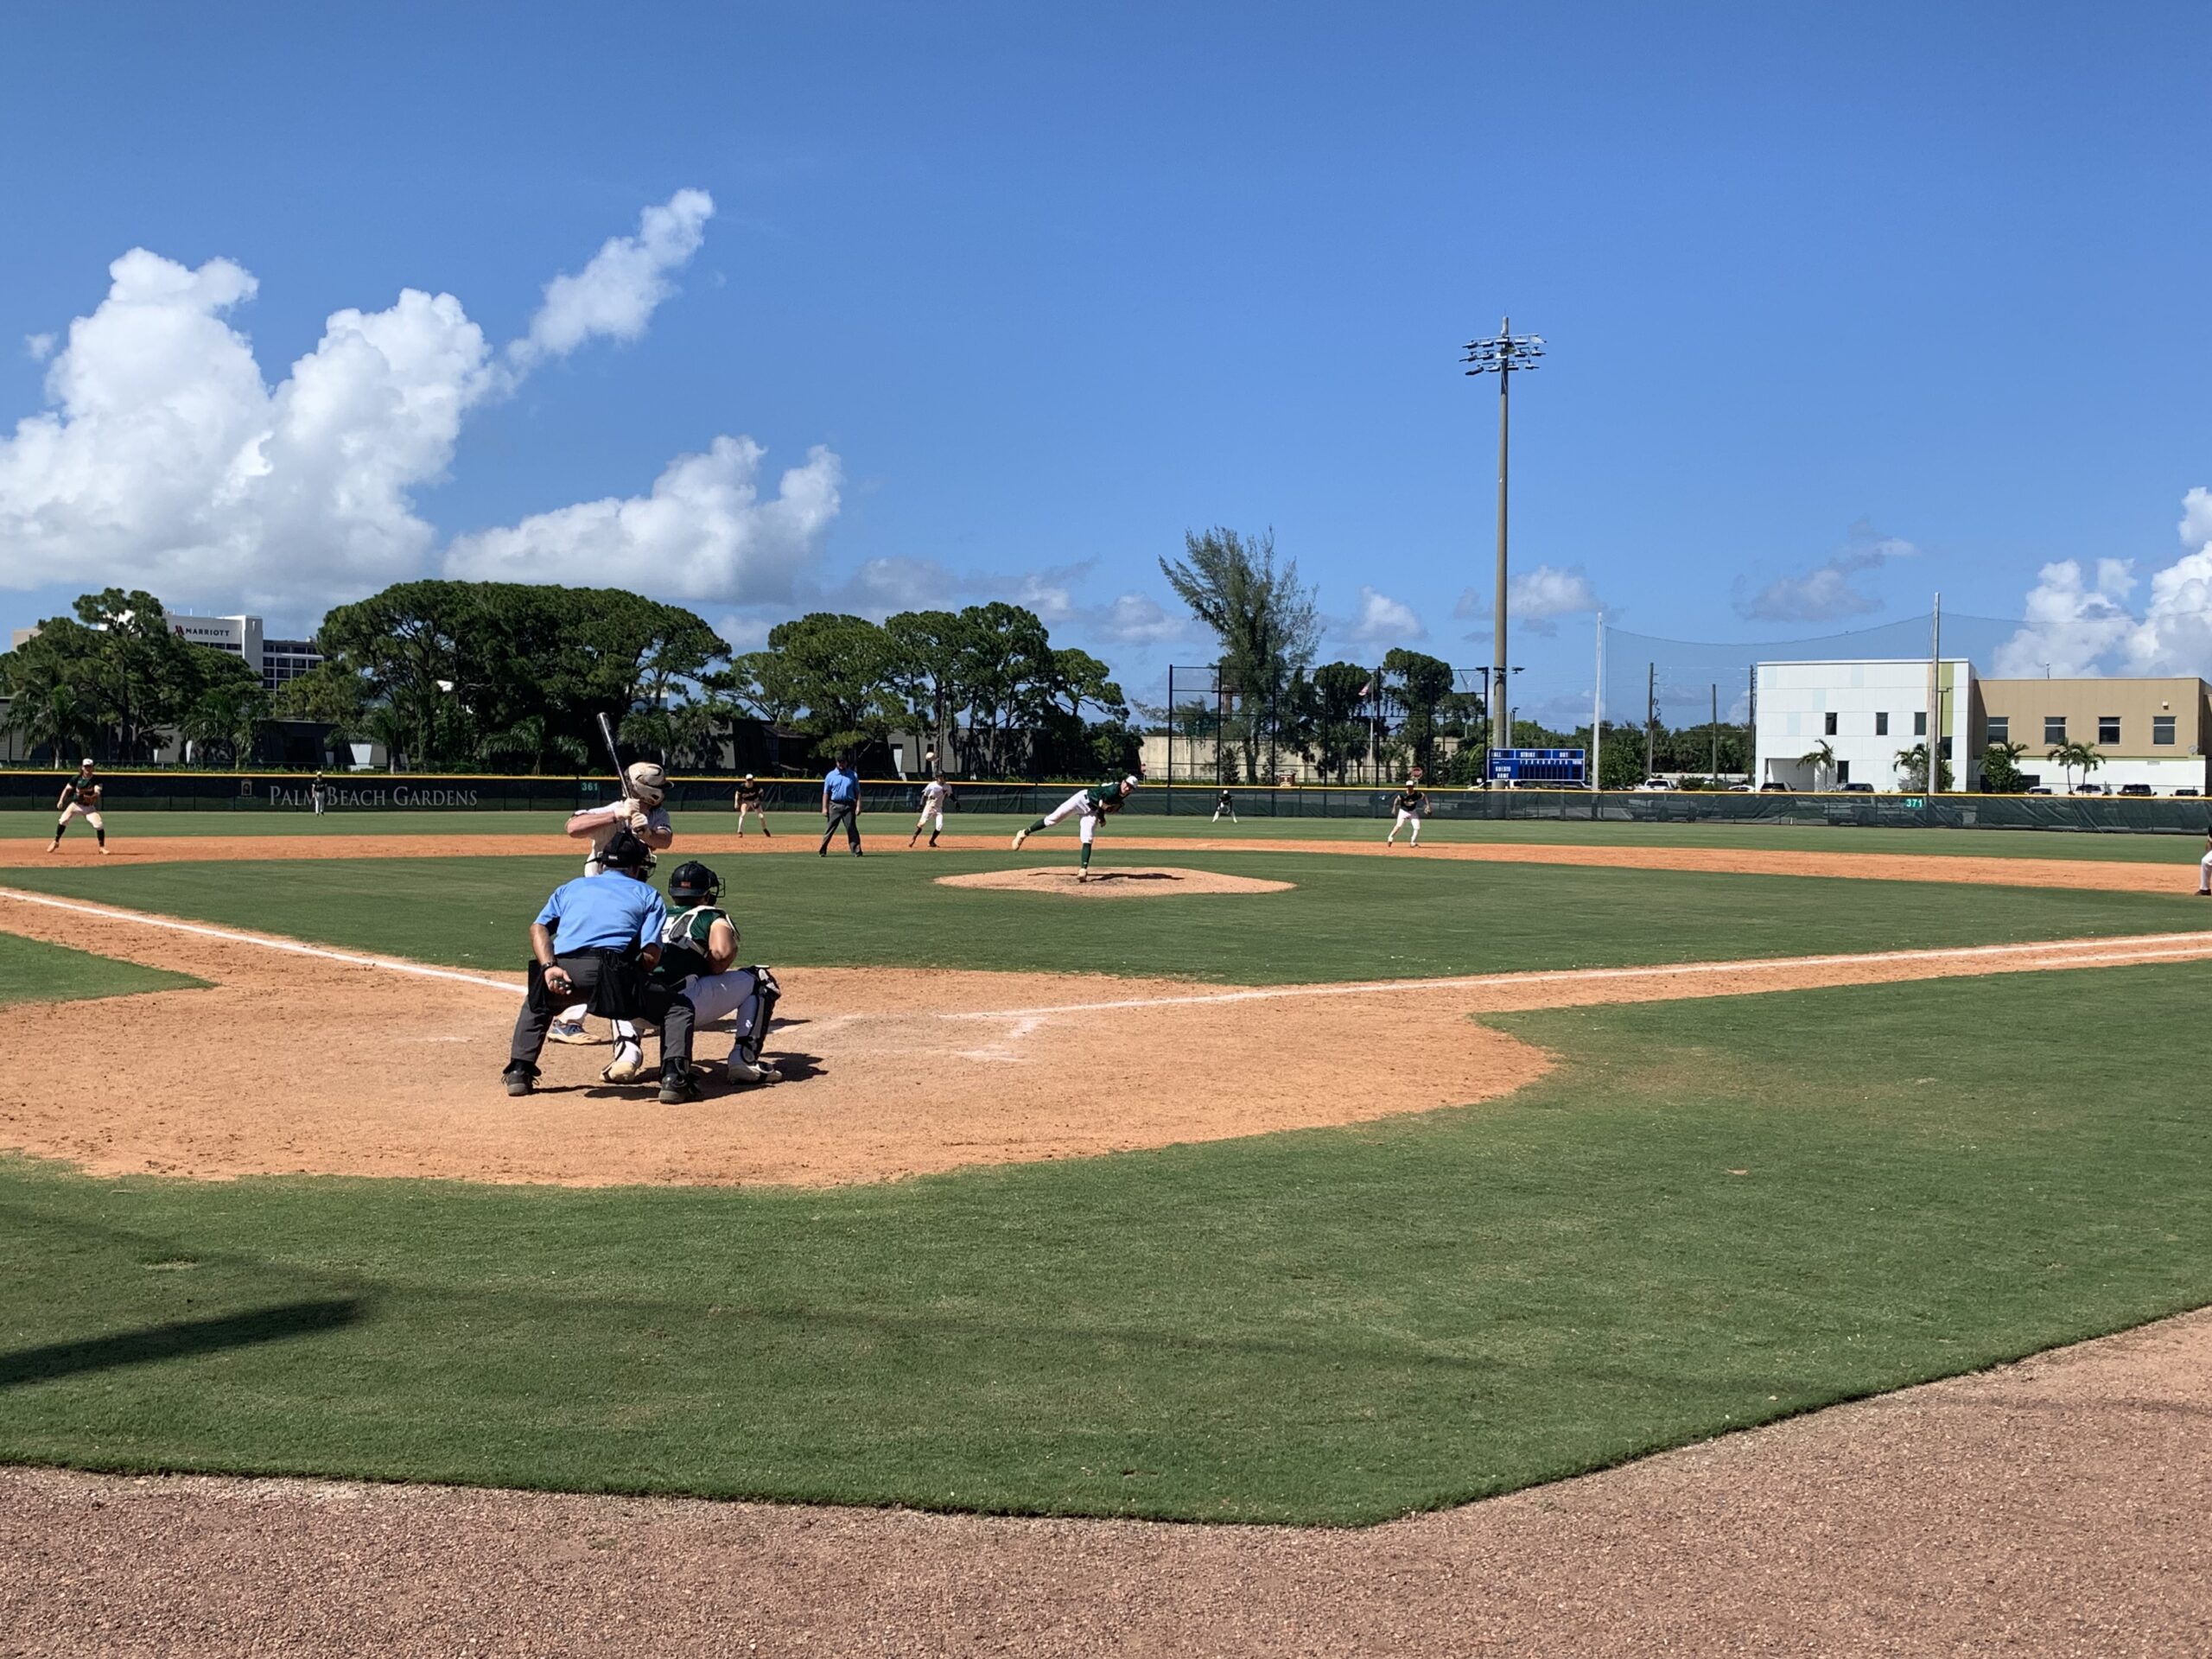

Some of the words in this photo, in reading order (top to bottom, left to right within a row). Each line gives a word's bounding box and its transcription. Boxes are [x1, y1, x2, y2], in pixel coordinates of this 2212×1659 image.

[186, 627, 230, 637] MARRIOTT
[582, 782, 598, 791] 361
[270, 785, 314, 806] PALM
[326, 786, 385, 806] BEACH
[393, 786, 478, 807] GARDENS
[1906, 798, 1923, 808] 371
